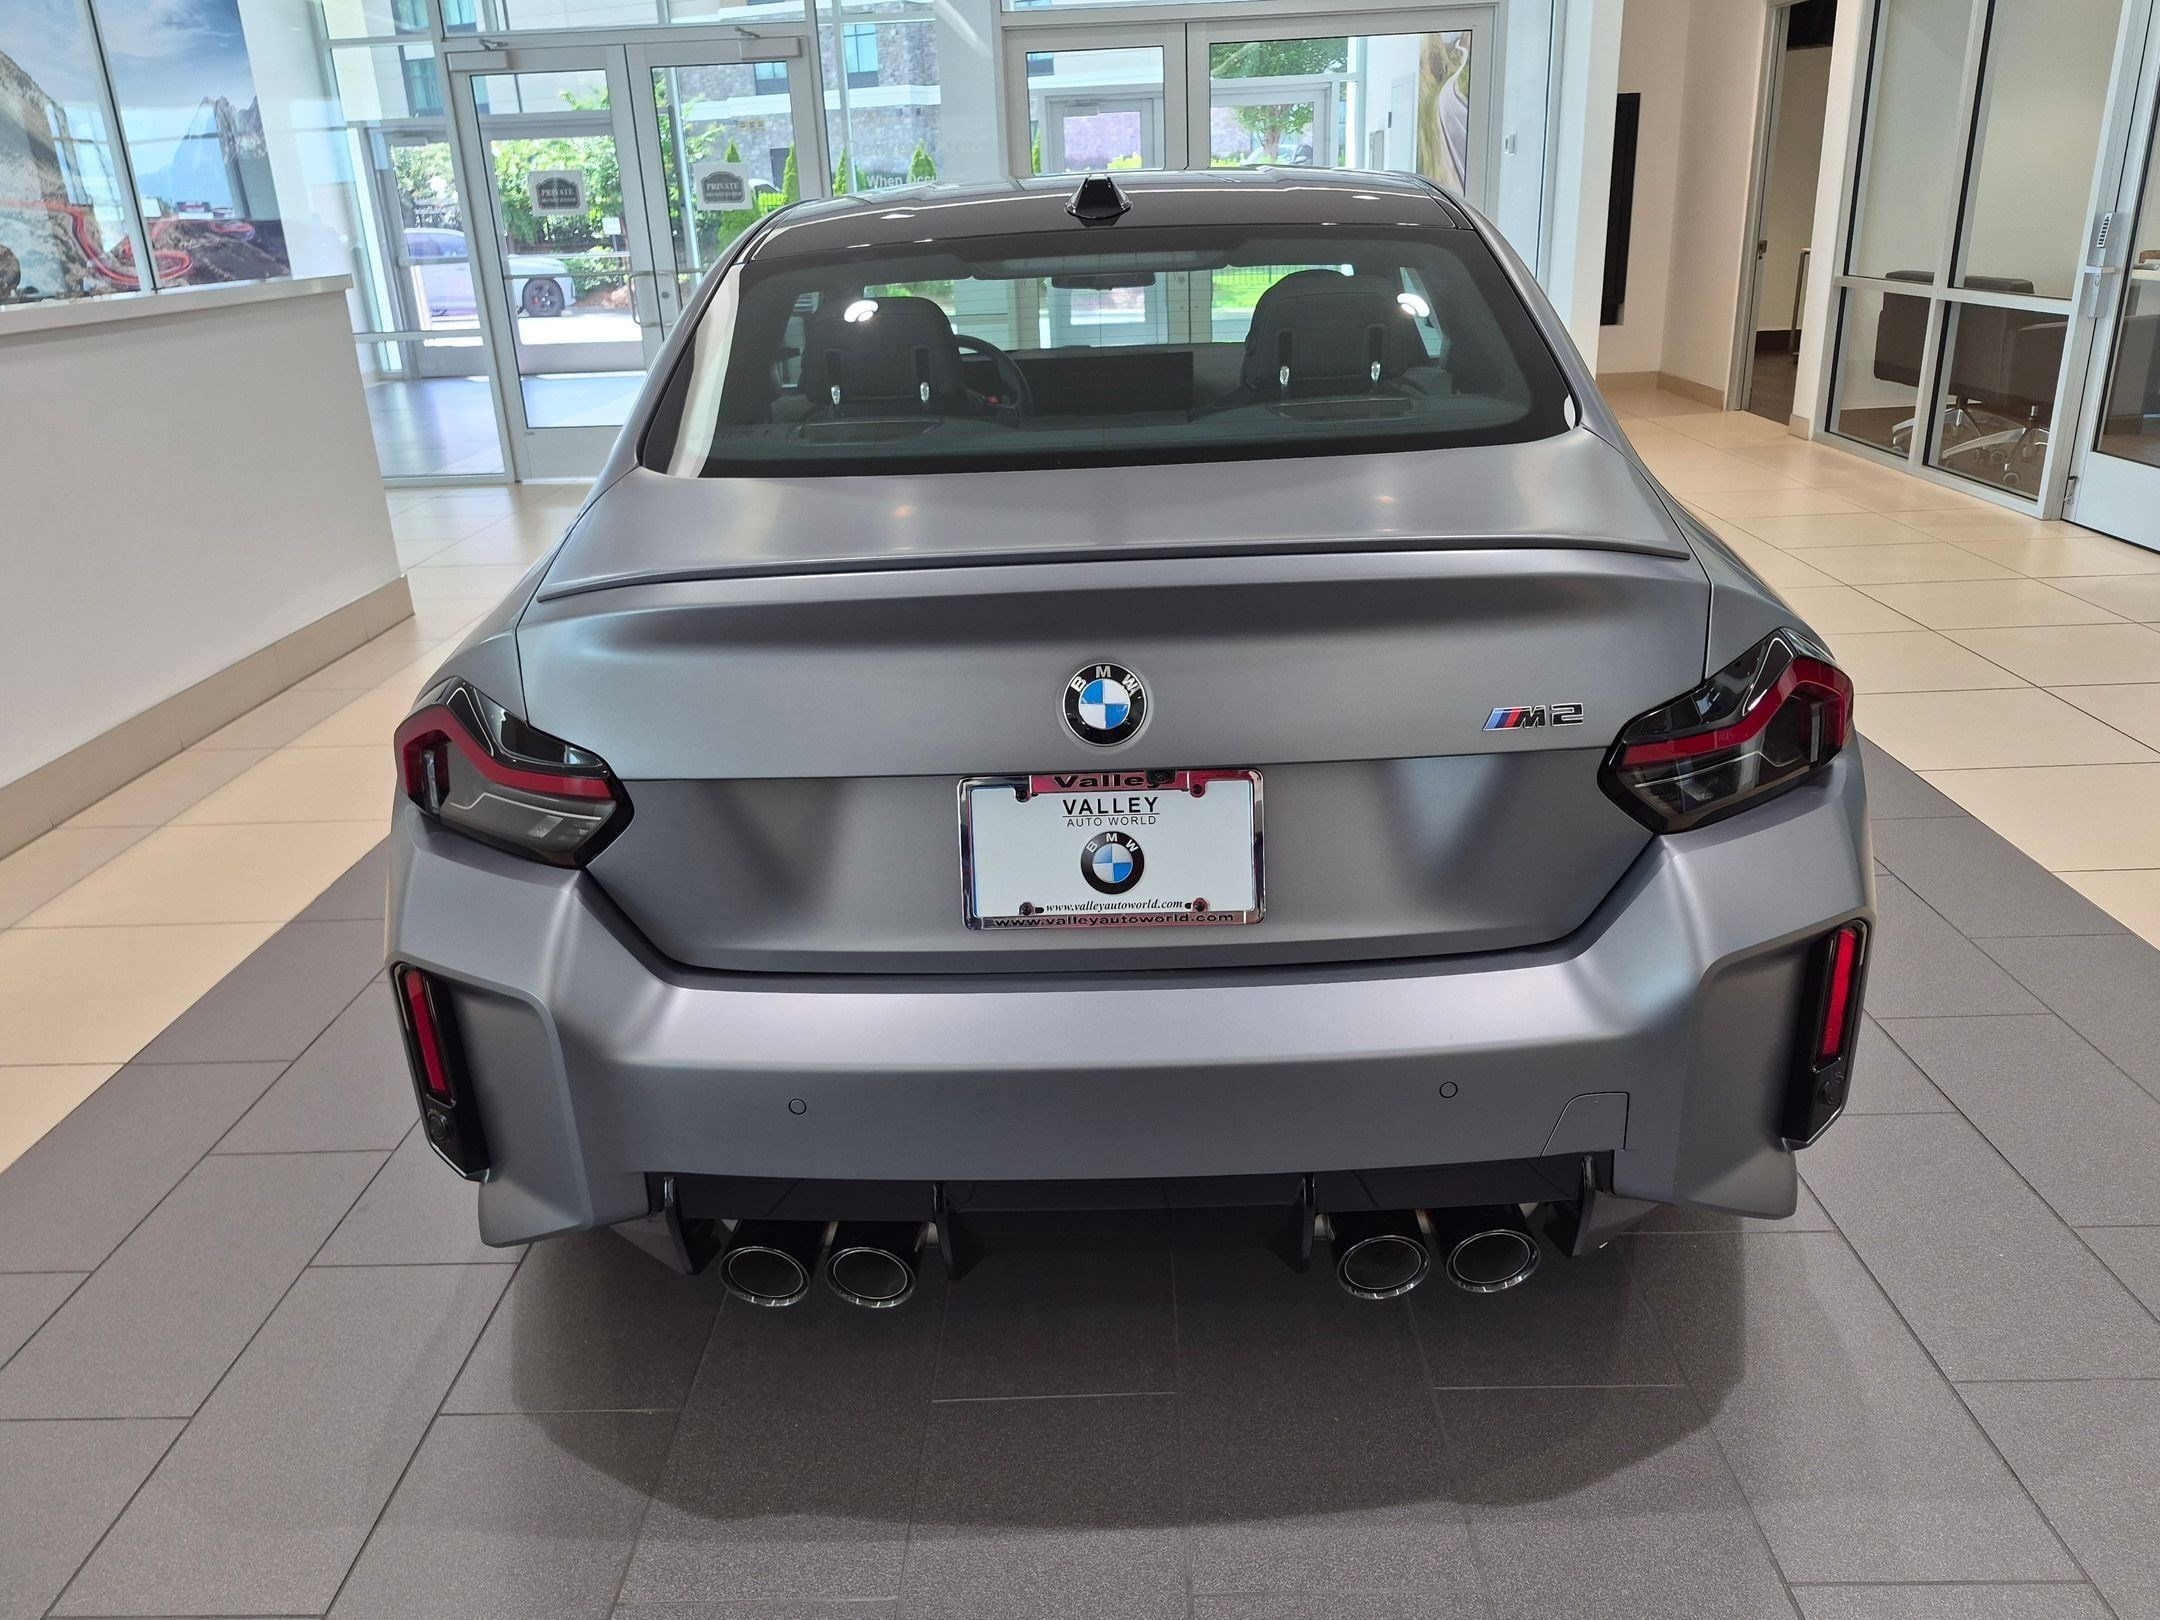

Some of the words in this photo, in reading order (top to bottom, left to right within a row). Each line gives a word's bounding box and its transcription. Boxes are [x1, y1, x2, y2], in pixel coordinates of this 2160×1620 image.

[867, 176, 903, 188] When
[1071, 665, 1141, 696] BMW
[1506, 703, 1584, 730] M2
[1062, 797, 1159, 815] VALLEY
[1066, 818, 1103, 828] AUTO
[1108, 815, 1157, 826] WORLD
[1086, 832, 1138, 853] BMW
[1046, 899, 1183, 913] www.valleyautoworld.com
[994, 913, 1234, 927] www.valleyautoworld.com
